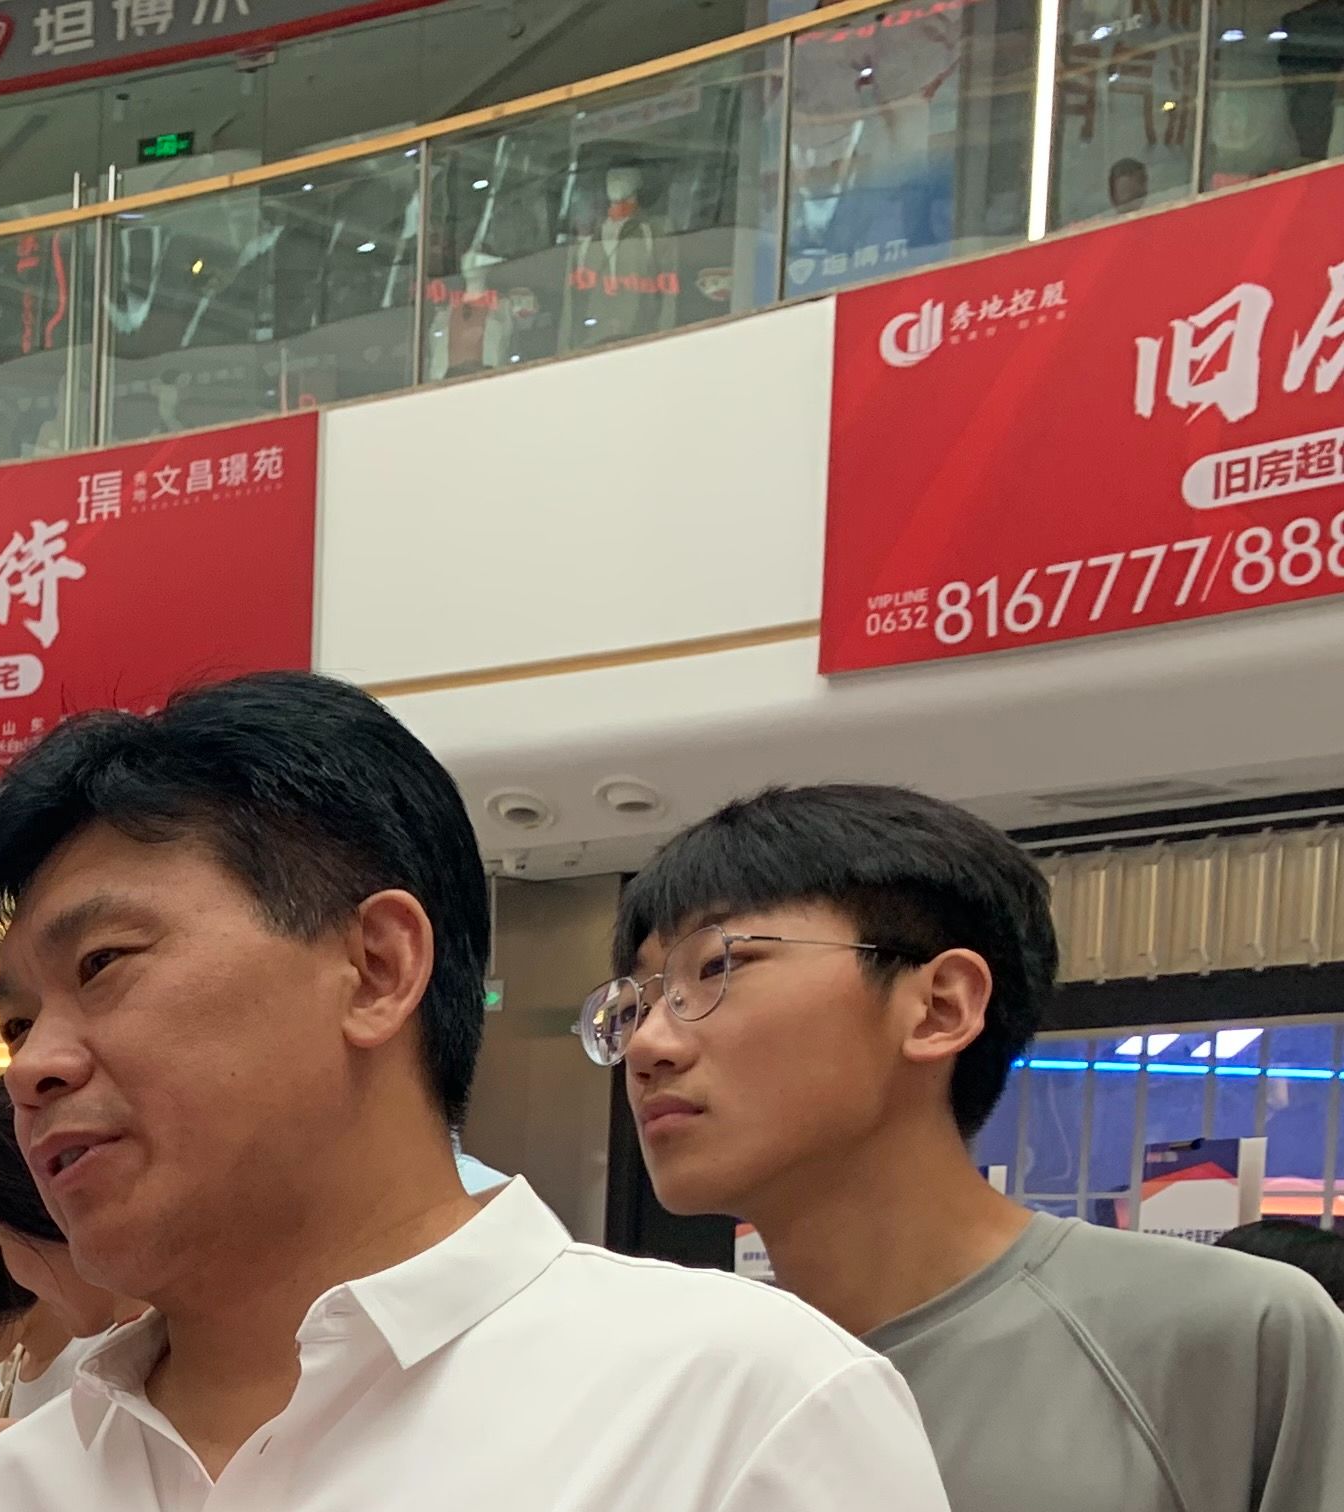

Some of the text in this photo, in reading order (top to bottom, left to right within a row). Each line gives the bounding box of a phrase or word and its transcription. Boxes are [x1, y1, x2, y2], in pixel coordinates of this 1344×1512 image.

[1213, 437, 1344, 500] 旧房超
[864, 604, 930, 638] 0632
